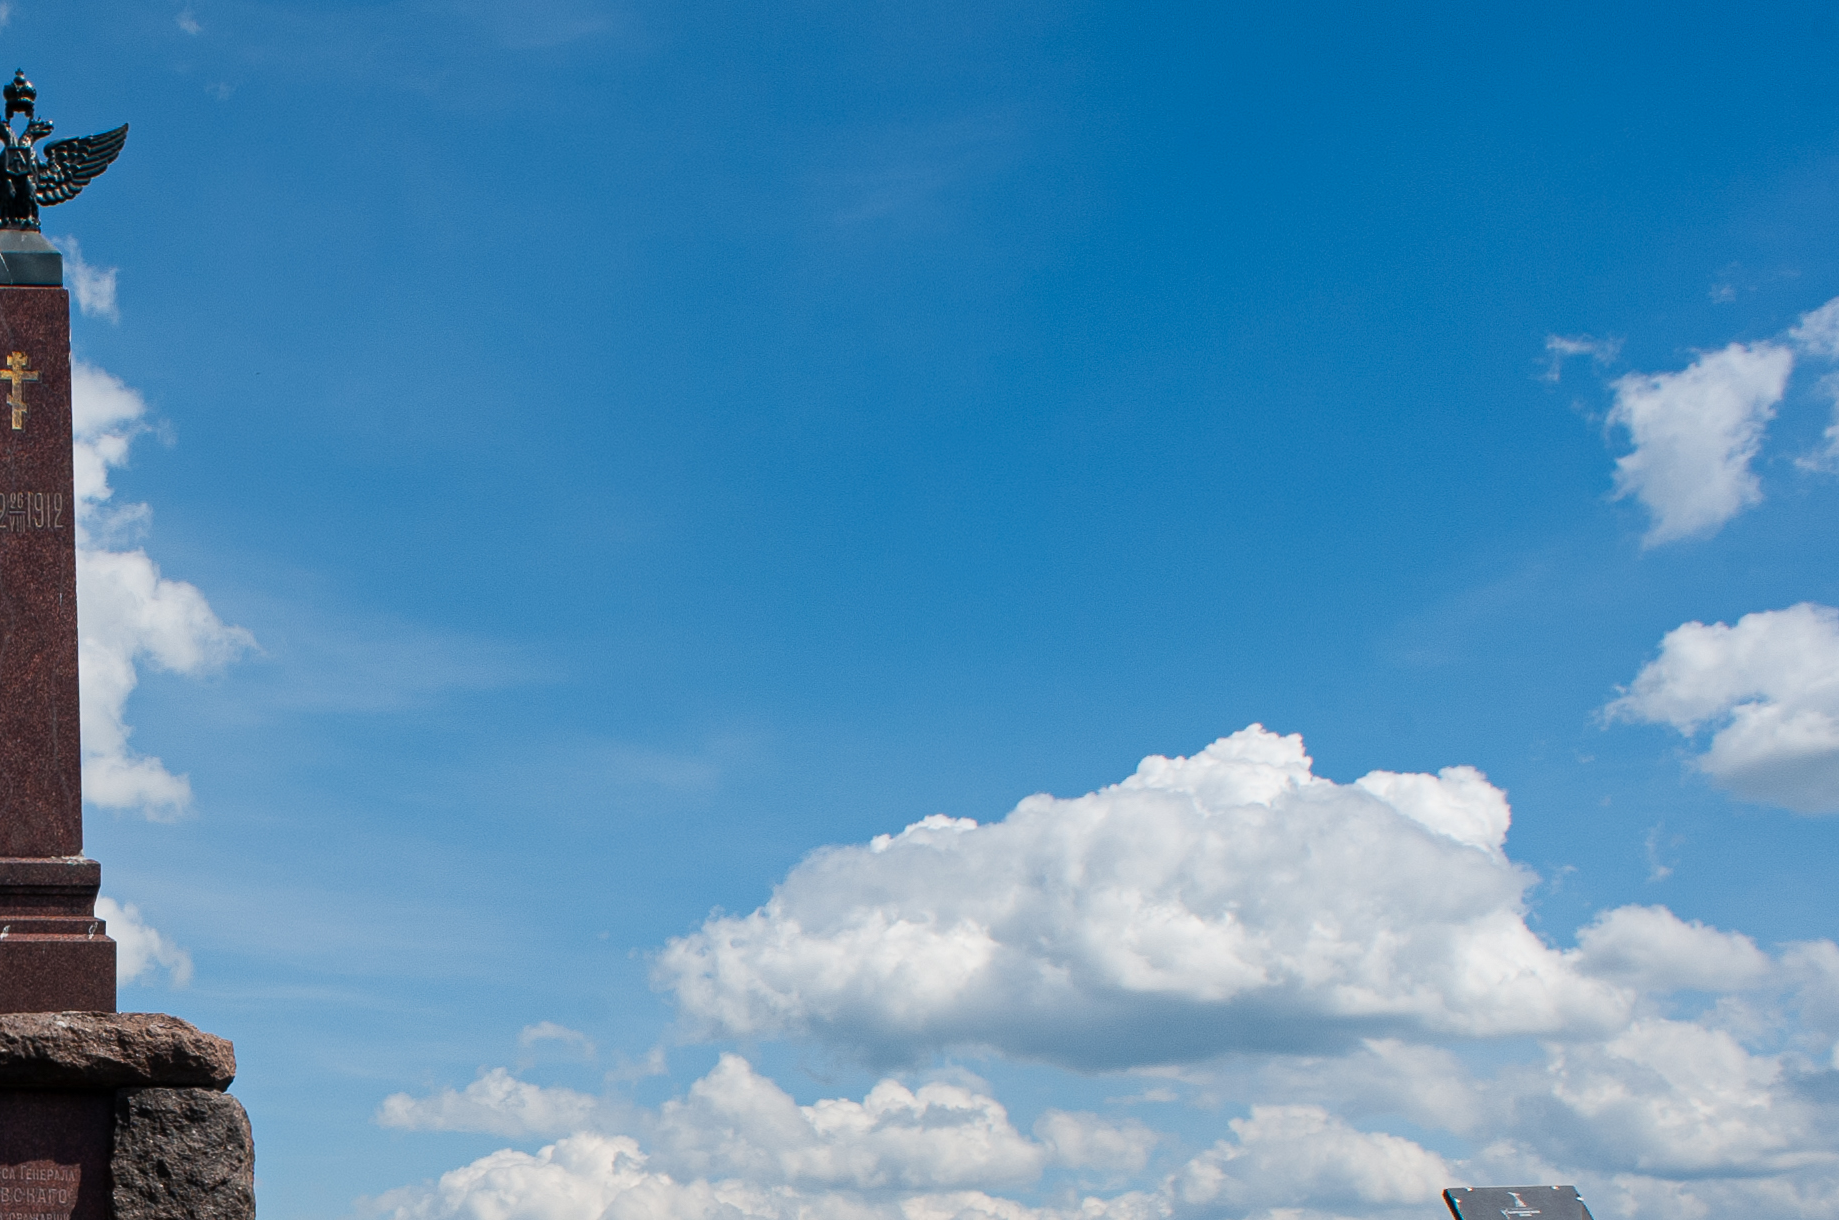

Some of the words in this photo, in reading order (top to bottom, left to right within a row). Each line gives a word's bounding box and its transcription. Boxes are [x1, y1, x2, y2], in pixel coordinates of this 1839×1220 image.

[9, 491, 24, 509] 26
[27, 491, 64, 528] 1912
[9, 515, 26, 532] VIII
[20, 1165, 76, 1182] ГЕНЕРАЛА
